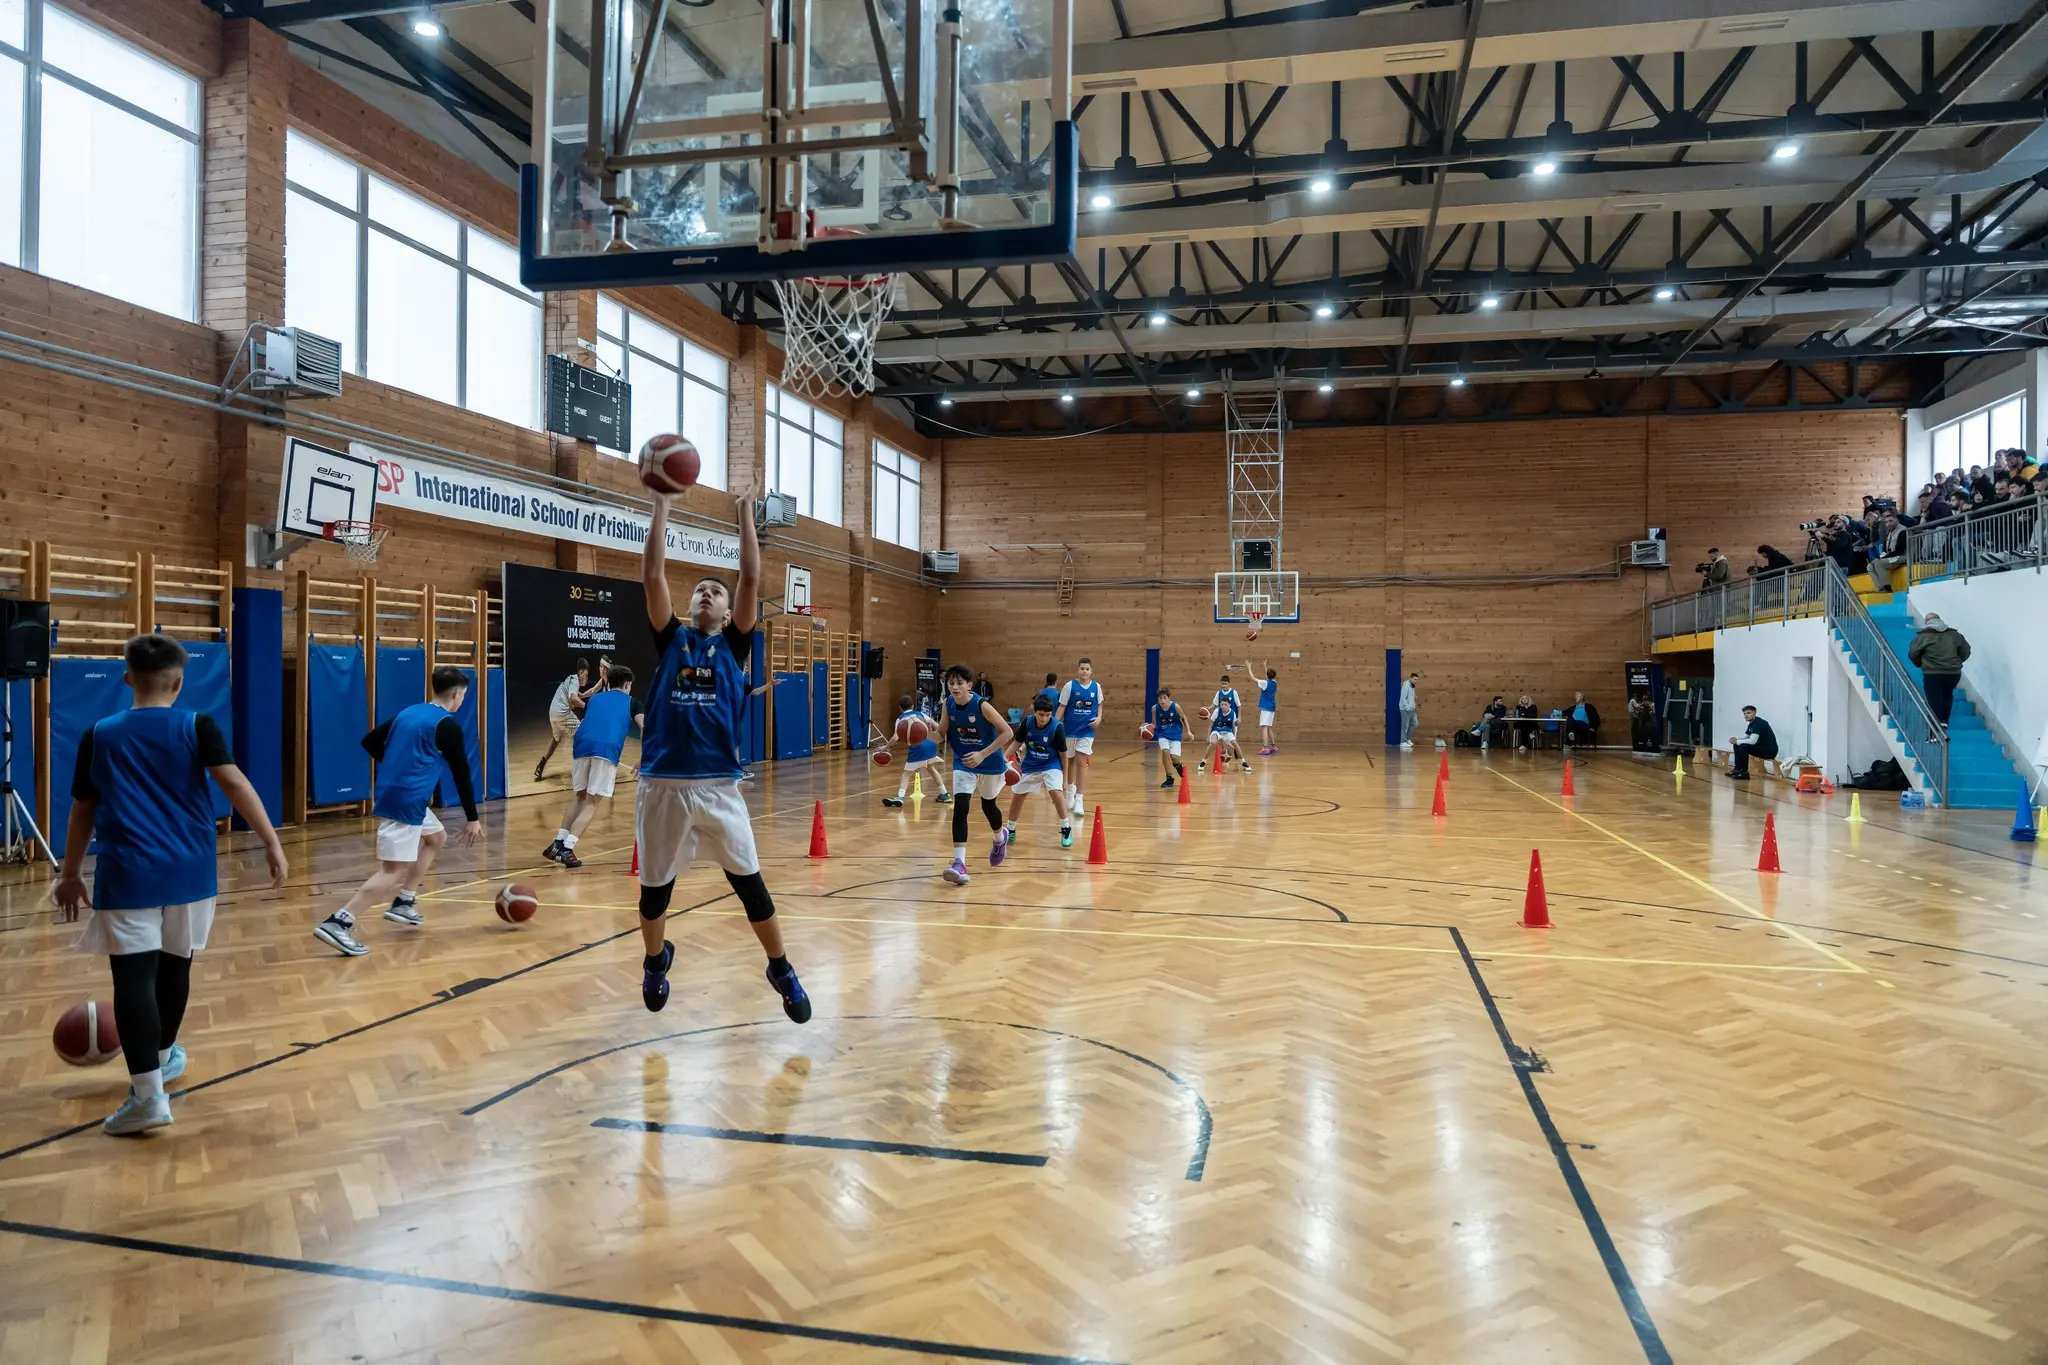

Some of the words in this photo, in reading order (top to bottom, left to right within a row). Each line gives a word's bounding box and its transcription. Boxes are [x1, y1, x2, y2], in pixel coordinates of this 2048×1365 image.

[574, 406, 587, 417] HOME
[599, 414, 612, 424] GUEST
[316, 465, 352, 482] elan
[414, 471, 526, 518] International
[530, 498, 580, 530] School
[582, 512, 596, 533] of
[706, 538, 740, 560] Sukses
[569, 586, 582, 599] 30
[574, 615, 587, 626] FIBA
[588, 616, 609, 628] EUROPE
[567, 627, 578, 639] U14
[579, 628, 615, 642] Get-Together
